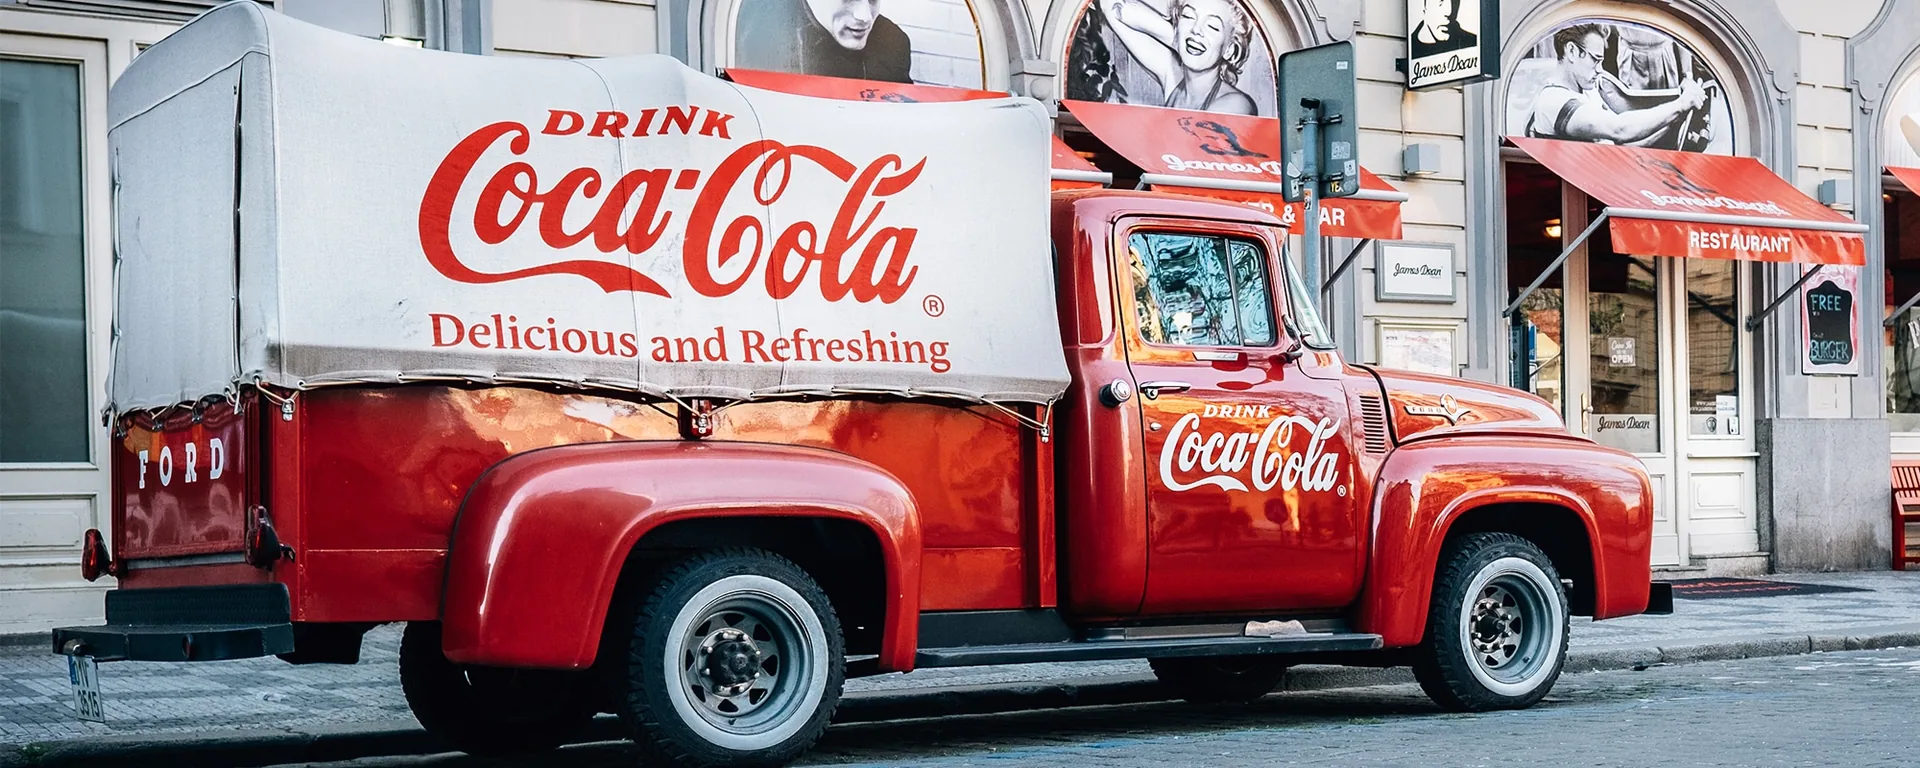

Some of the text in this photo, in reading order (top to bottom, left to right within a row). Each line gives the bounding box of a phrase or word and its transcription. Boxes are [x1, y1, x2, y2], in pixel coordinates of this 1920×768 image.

[1411, 54, 1478, 85] James Dean
[541, 105, 735, 139] DRINK
[418, 121, 928, 304] Coca-Cola
[1319, 206, 1346, 226] AR
[1689, 231, 1791, 253] RESTAURANT
[1393, 262, 1442, 277] James Dean
[1810, 294, 1842, 312] FREE
[428, 313, 951, 374] Delicious and Refreshing
[1810, 339, 1850, 361] BURGER
[1611, 354, 1633, 364] OPEN
[1202, 404, 1272, 418] DRINK
[1597, 416, 1650, 433] James Dean
[138, 437, 225, 490] FORD
[1159, 412, 1341, 493] Coca-Cola
[77, 689, 100, 718] 3515
